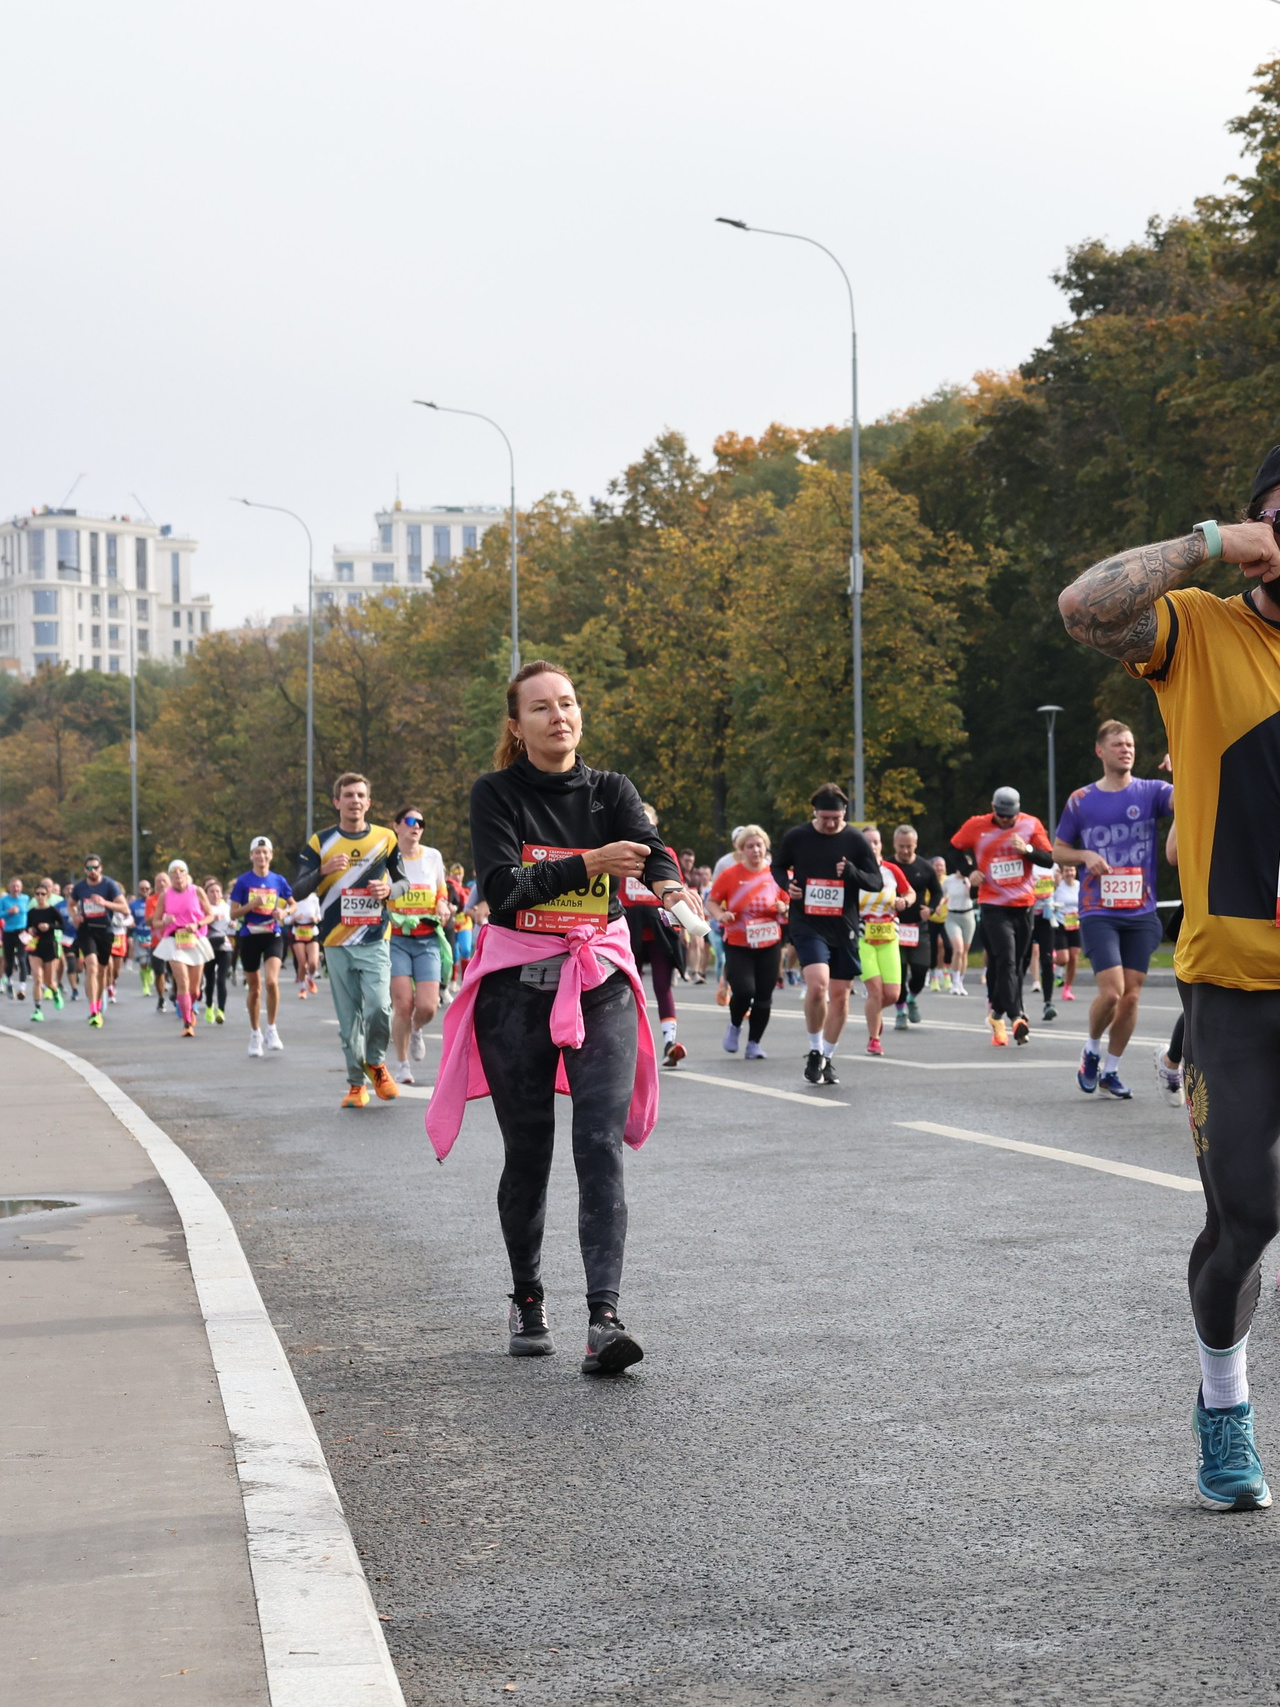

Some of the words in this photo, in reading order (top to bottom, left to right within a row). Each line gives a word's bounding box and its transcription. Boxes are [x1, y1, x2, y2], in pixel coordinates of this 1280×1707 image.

[993, 861, 1022, 874] 21017
[1103, 881, 1142, 893] 32317
[810, 888, 839, 900] 4082
[343, 898, 380, 910] 25946
[545, 899, 582, 907] НАТАЛЬЯ
[525, 912, 537, 928] D
[749, 926, 778, 938] 29793
